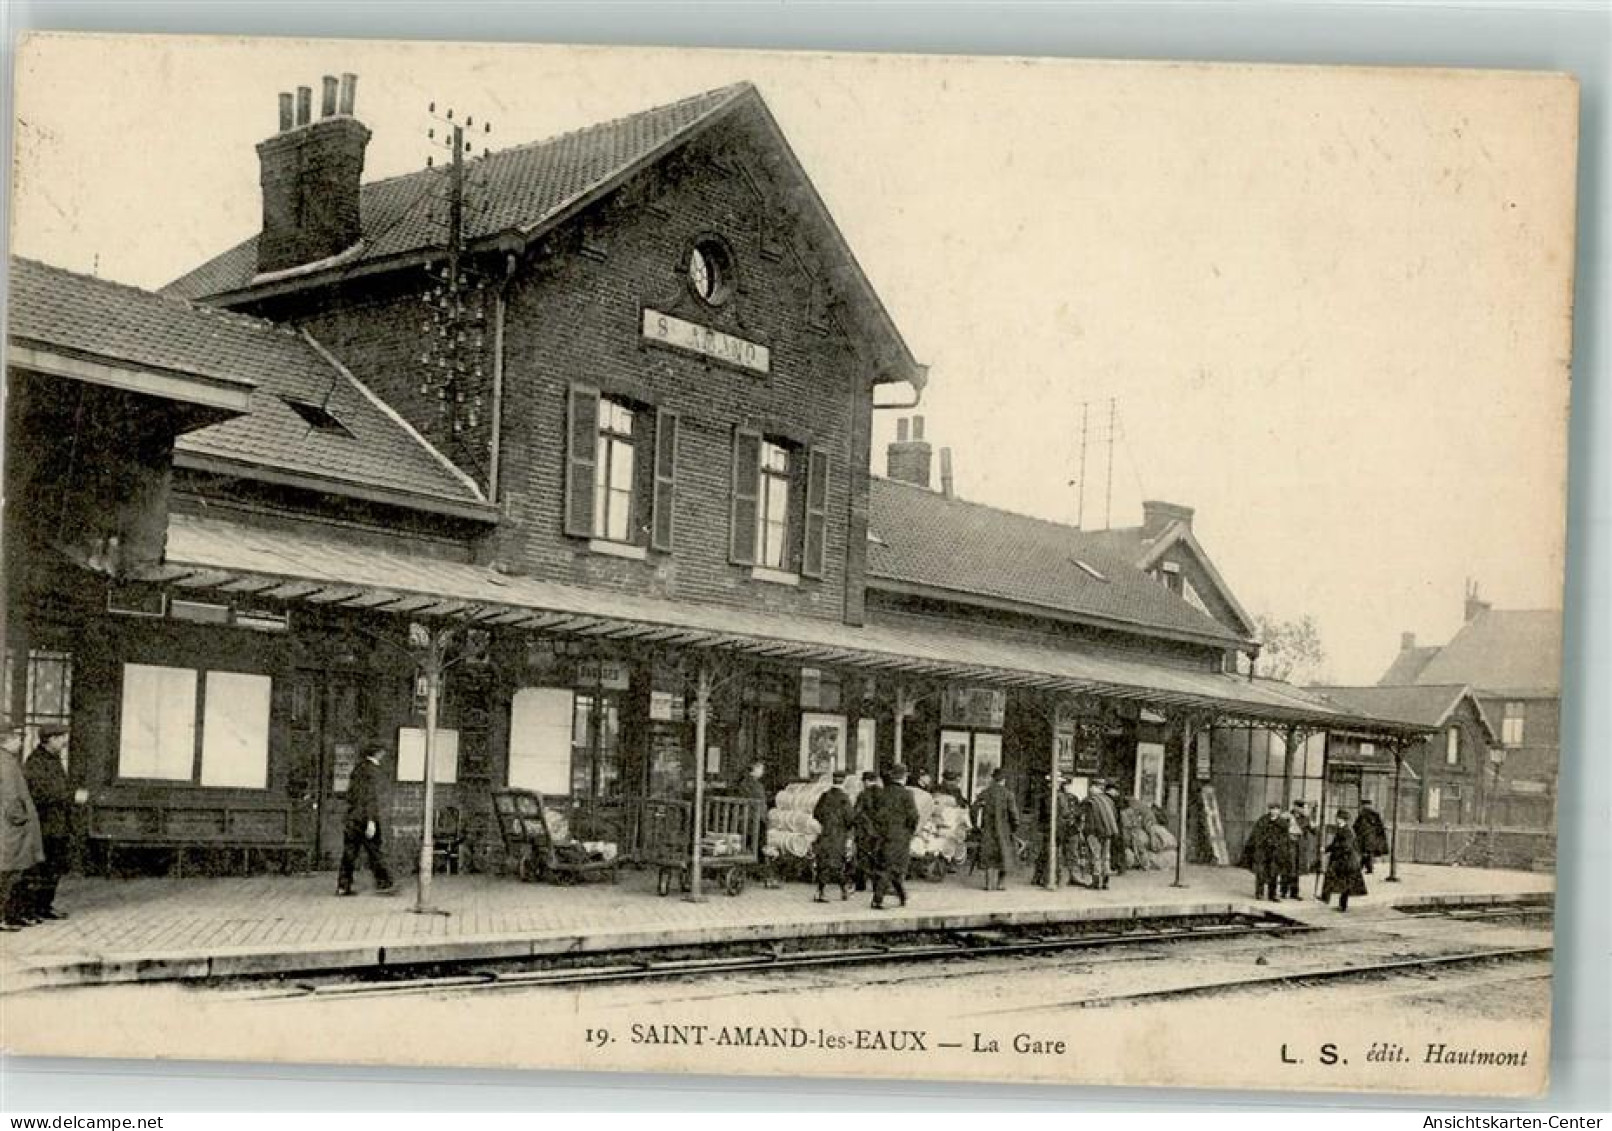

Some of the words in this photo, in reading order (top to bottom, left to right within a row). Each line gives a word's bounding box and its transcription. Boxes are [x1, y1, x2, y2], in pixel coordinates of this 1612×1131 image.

[585, 1028, 617, 1048] 19.
[630, 1023, 928, 1052] SAINT-AMAND-les-EAUX
[971, 1032, 1000, 1053] La
[1013, 1033, 1067, 1055] Gare
[1280, 1043, 1304, 1064] L.
[1319, 1042, 1349, 1065] S.
[1366, 1042, 1410, 1063] édit.
[1423, 1042, 1528, 1067] Hautmont
